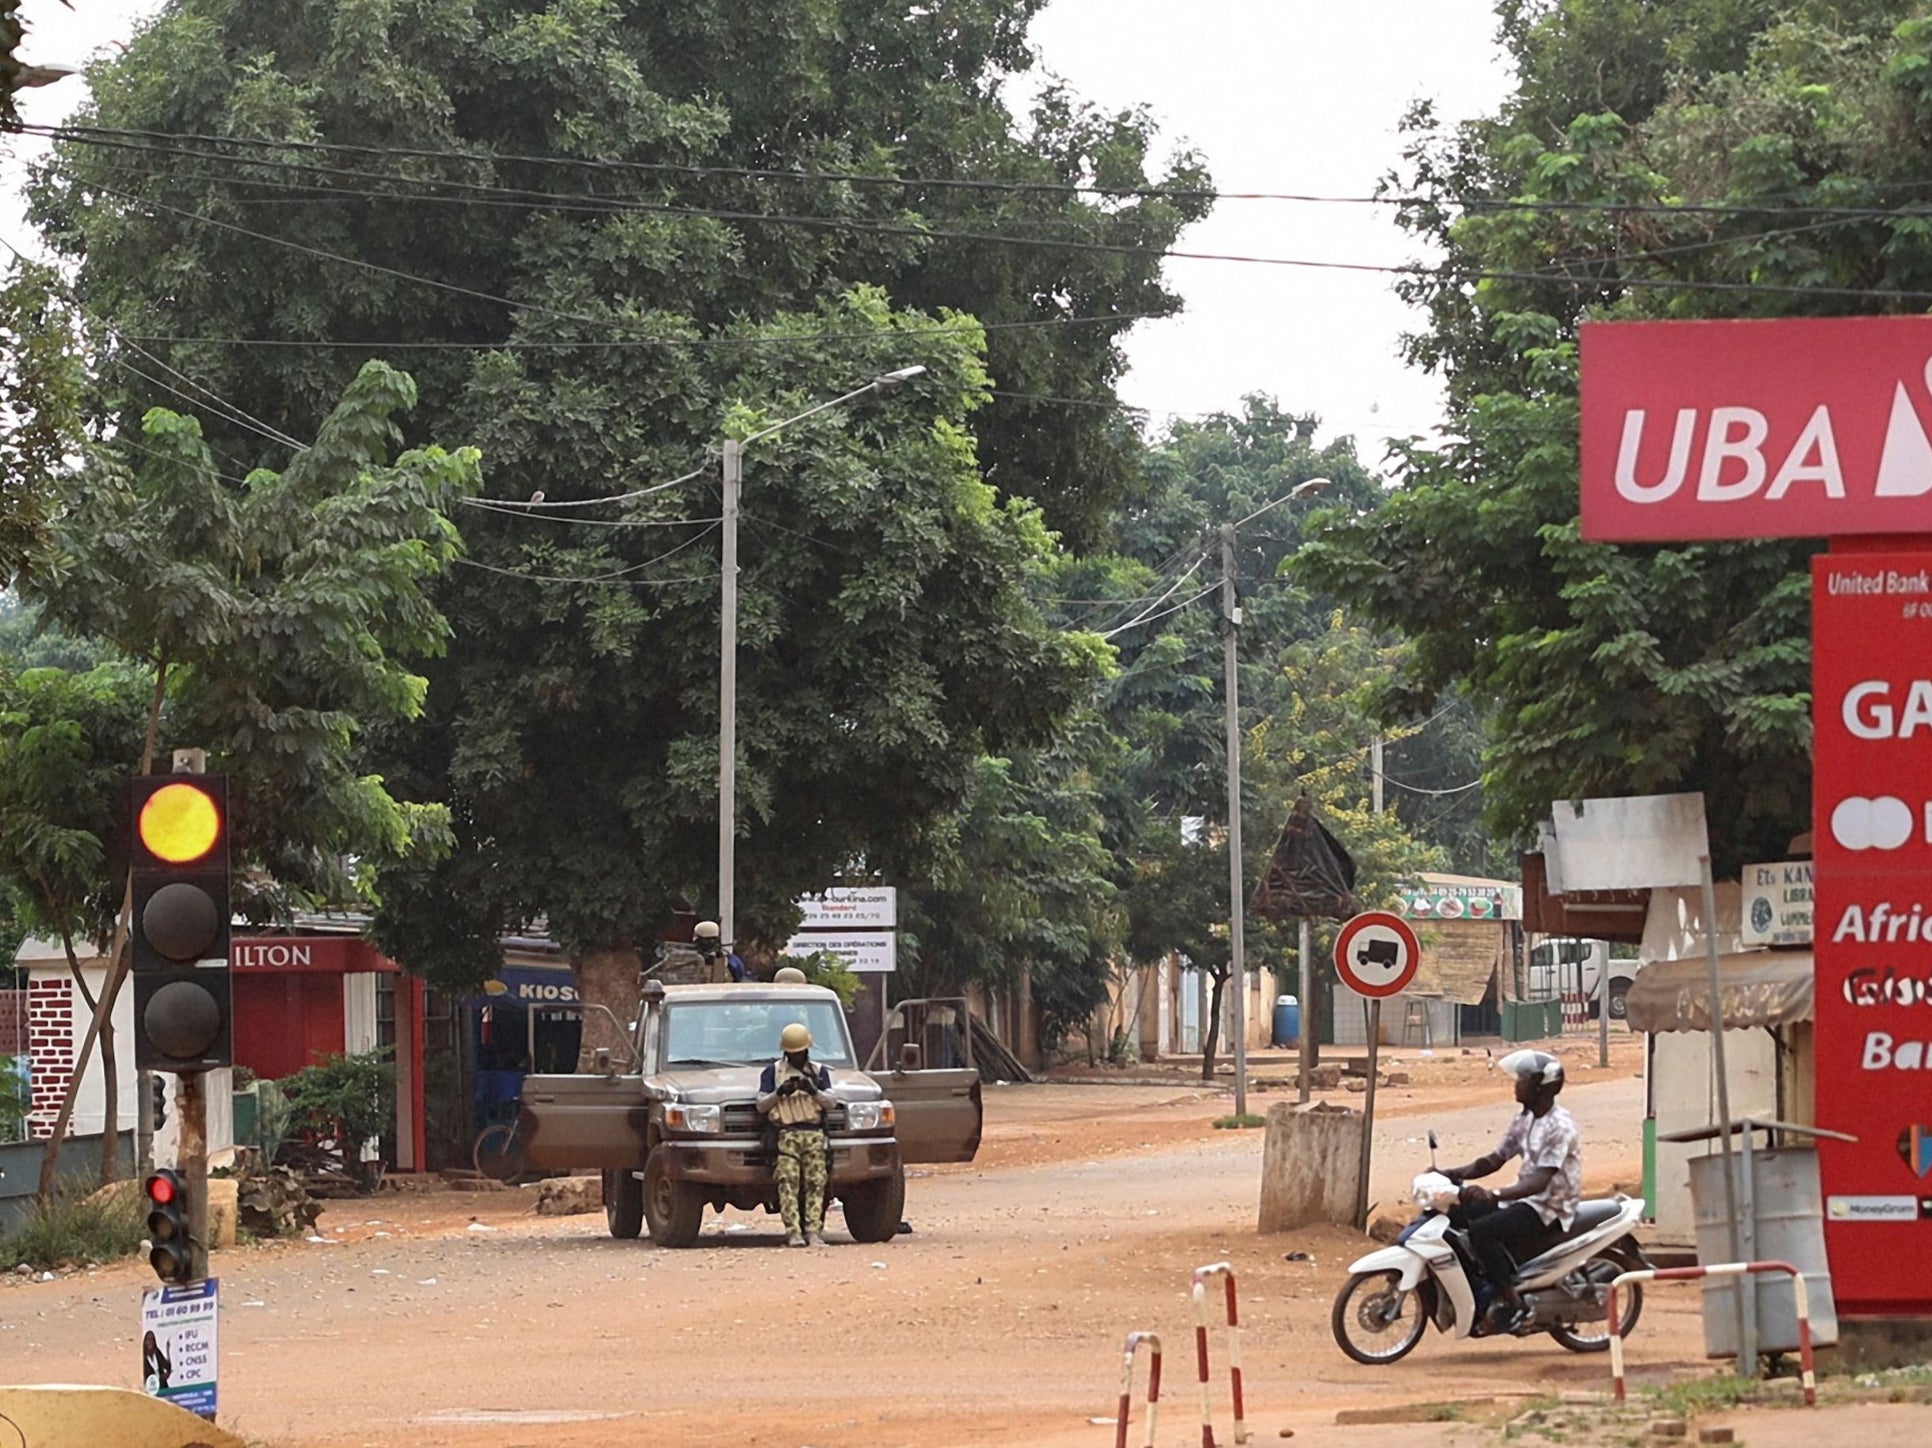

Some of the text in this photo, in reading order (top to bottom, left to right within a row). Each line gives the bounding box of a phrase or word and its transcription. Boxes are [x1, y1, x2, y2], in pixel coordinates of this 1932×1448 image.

[1614, 404, 1846, 504] UBA
[1827, 569, 1930, 595] United Bank
[519, 984, 579, 1002] KIOS
